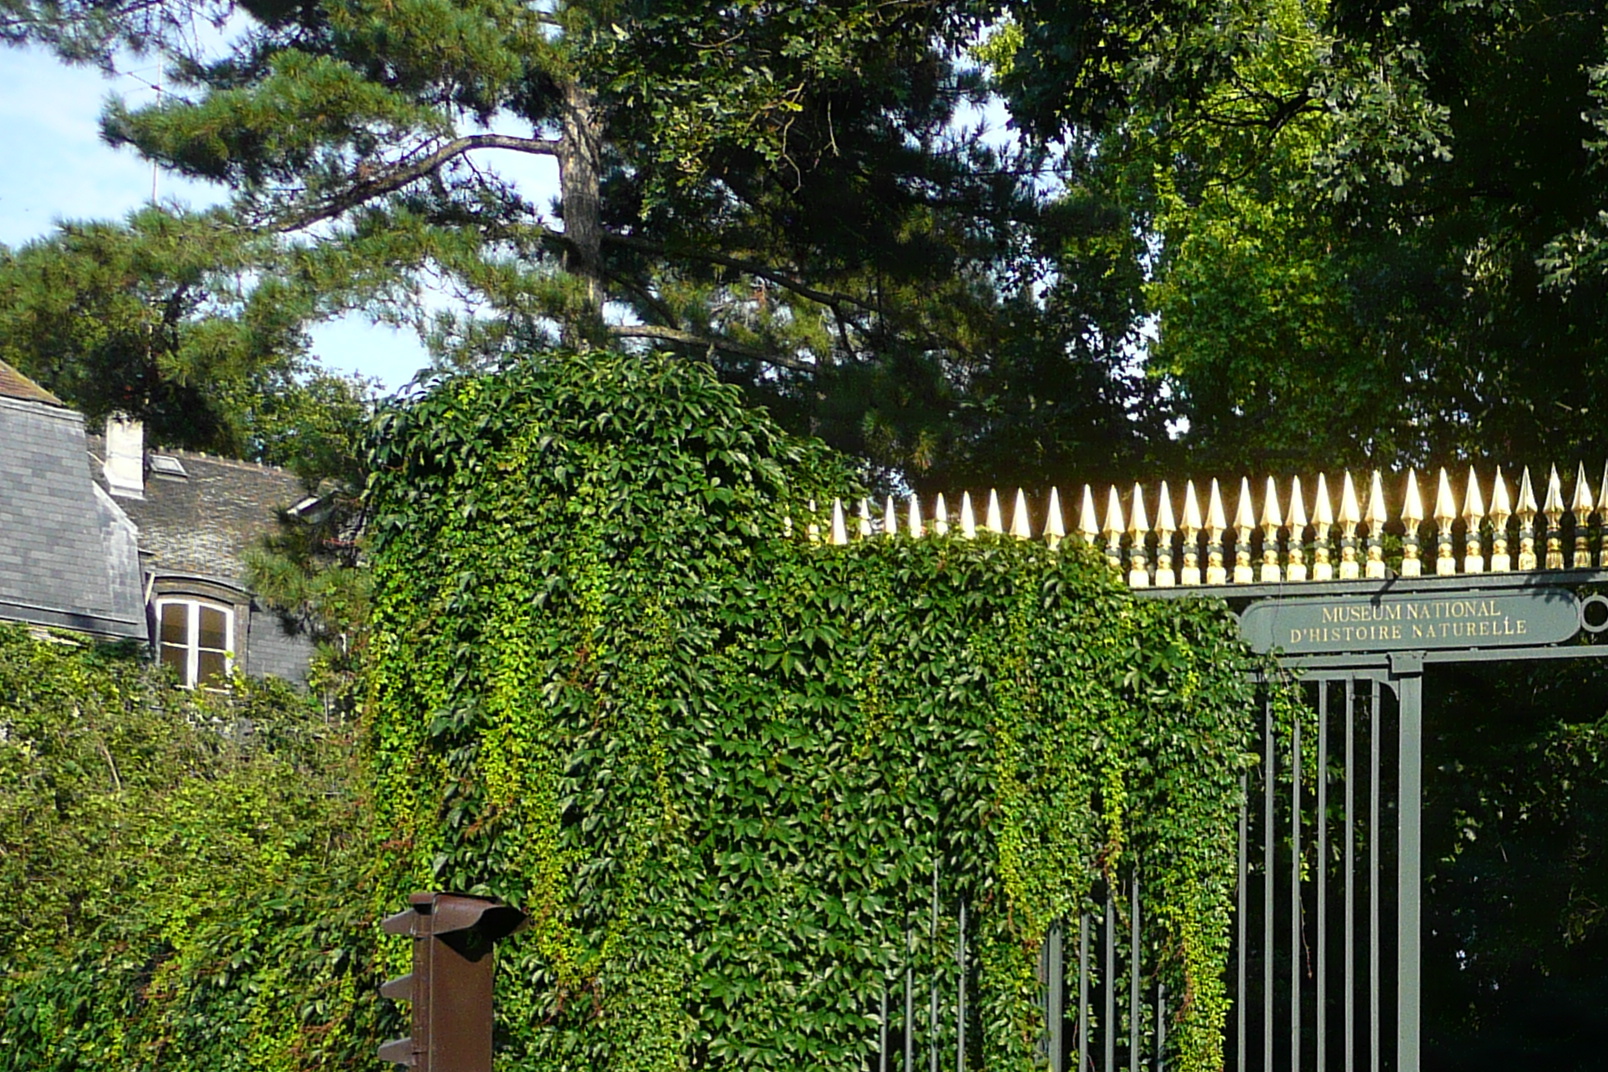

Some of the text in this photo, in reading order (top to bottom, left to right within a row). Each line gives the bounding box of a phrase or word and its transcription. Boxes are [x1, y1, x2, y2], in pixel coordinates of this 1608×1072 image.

[1322, 600, 1501, 623] MUSEUM NATIONAL
[1290, 619, 1527, 644] D'HISTOIRE NATURELLE
